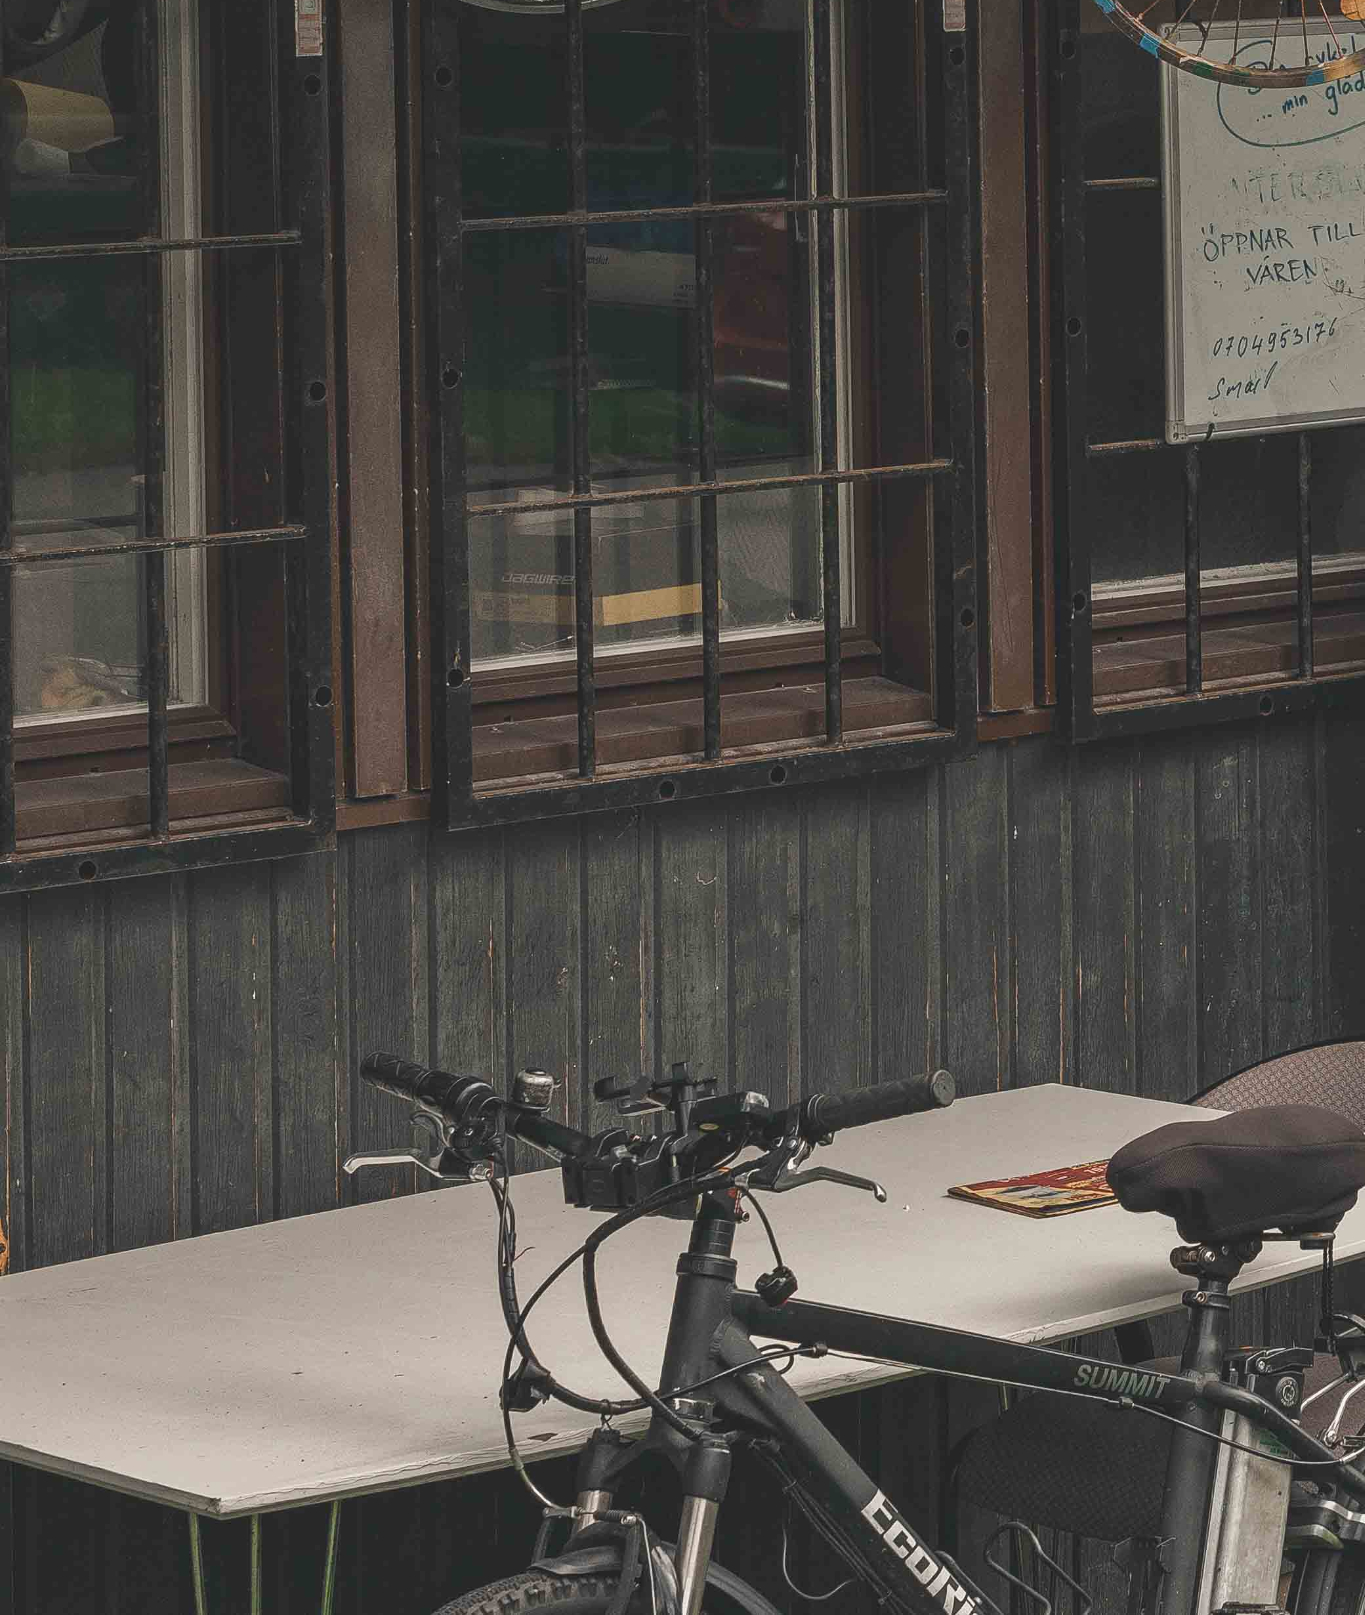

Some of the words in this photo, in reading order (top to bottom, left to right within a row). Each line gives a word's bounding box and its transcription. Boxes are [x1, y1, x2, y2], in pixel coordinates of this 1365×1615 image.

[1281, 91, 1309, 115] min
[1201, 222, 1294, 262] ÖPPNAR
[1307, 222, 1362, 246] TILL
[1073, 1363, 1172, 1400] SUMMIT
